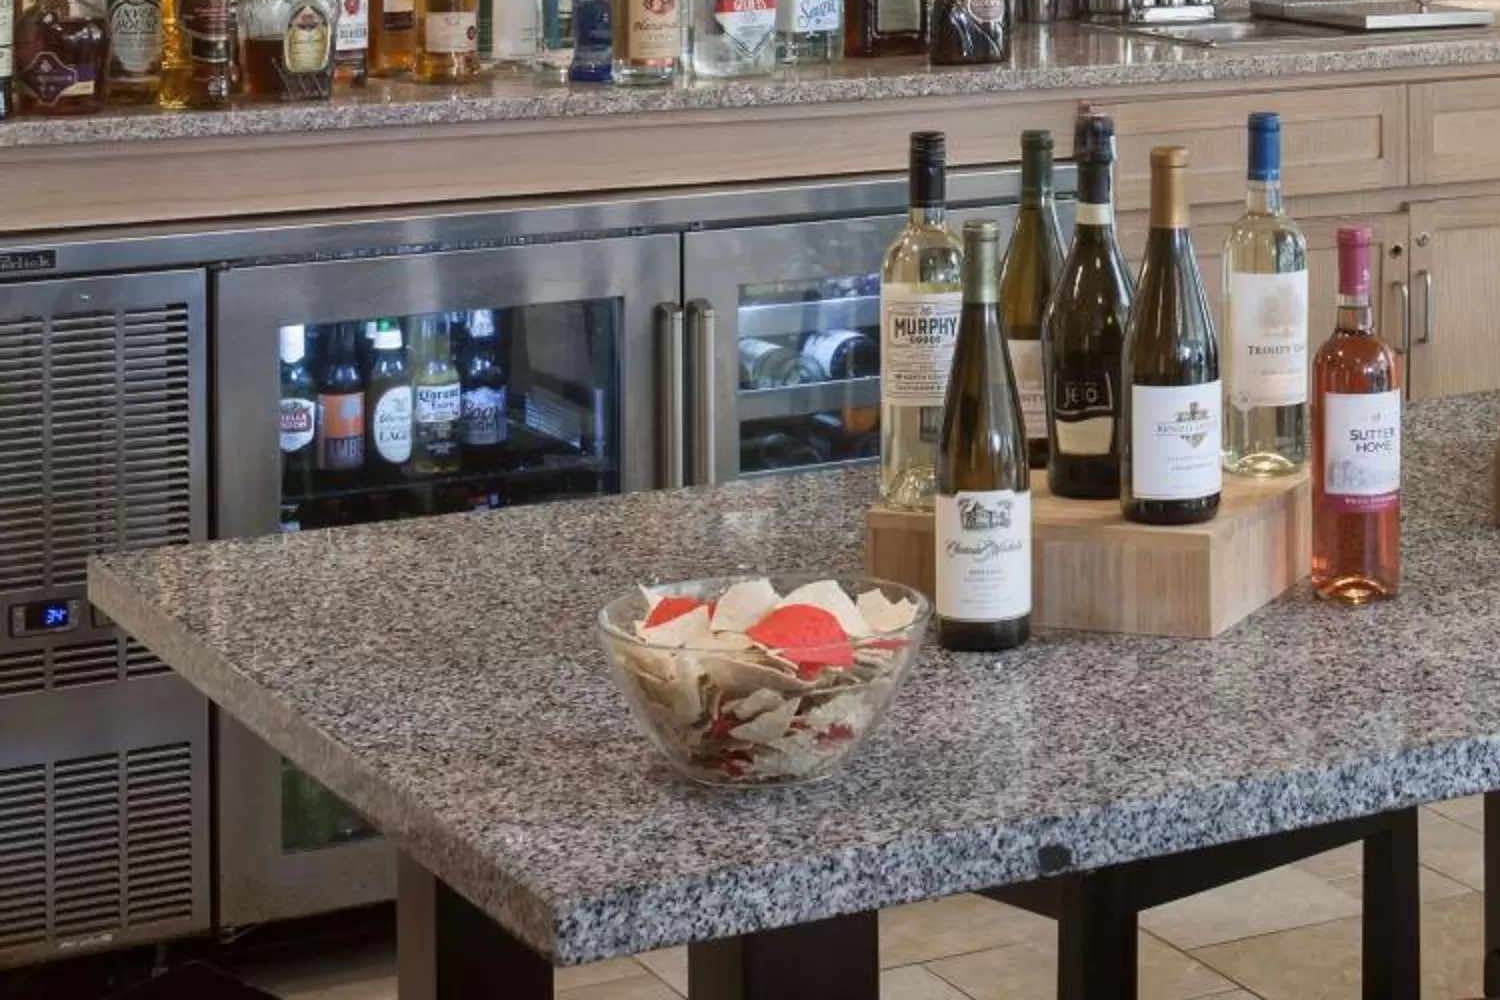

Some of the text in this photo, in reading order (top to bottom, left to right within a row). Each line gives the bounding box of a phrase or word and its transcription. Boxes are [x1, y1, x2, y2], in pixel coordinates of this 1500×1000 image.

[894, 316, 957, 338] MURPHY
[1349, 427, 1395, 441] SUTTER
[1355, 441, 1393, 453] HOME
